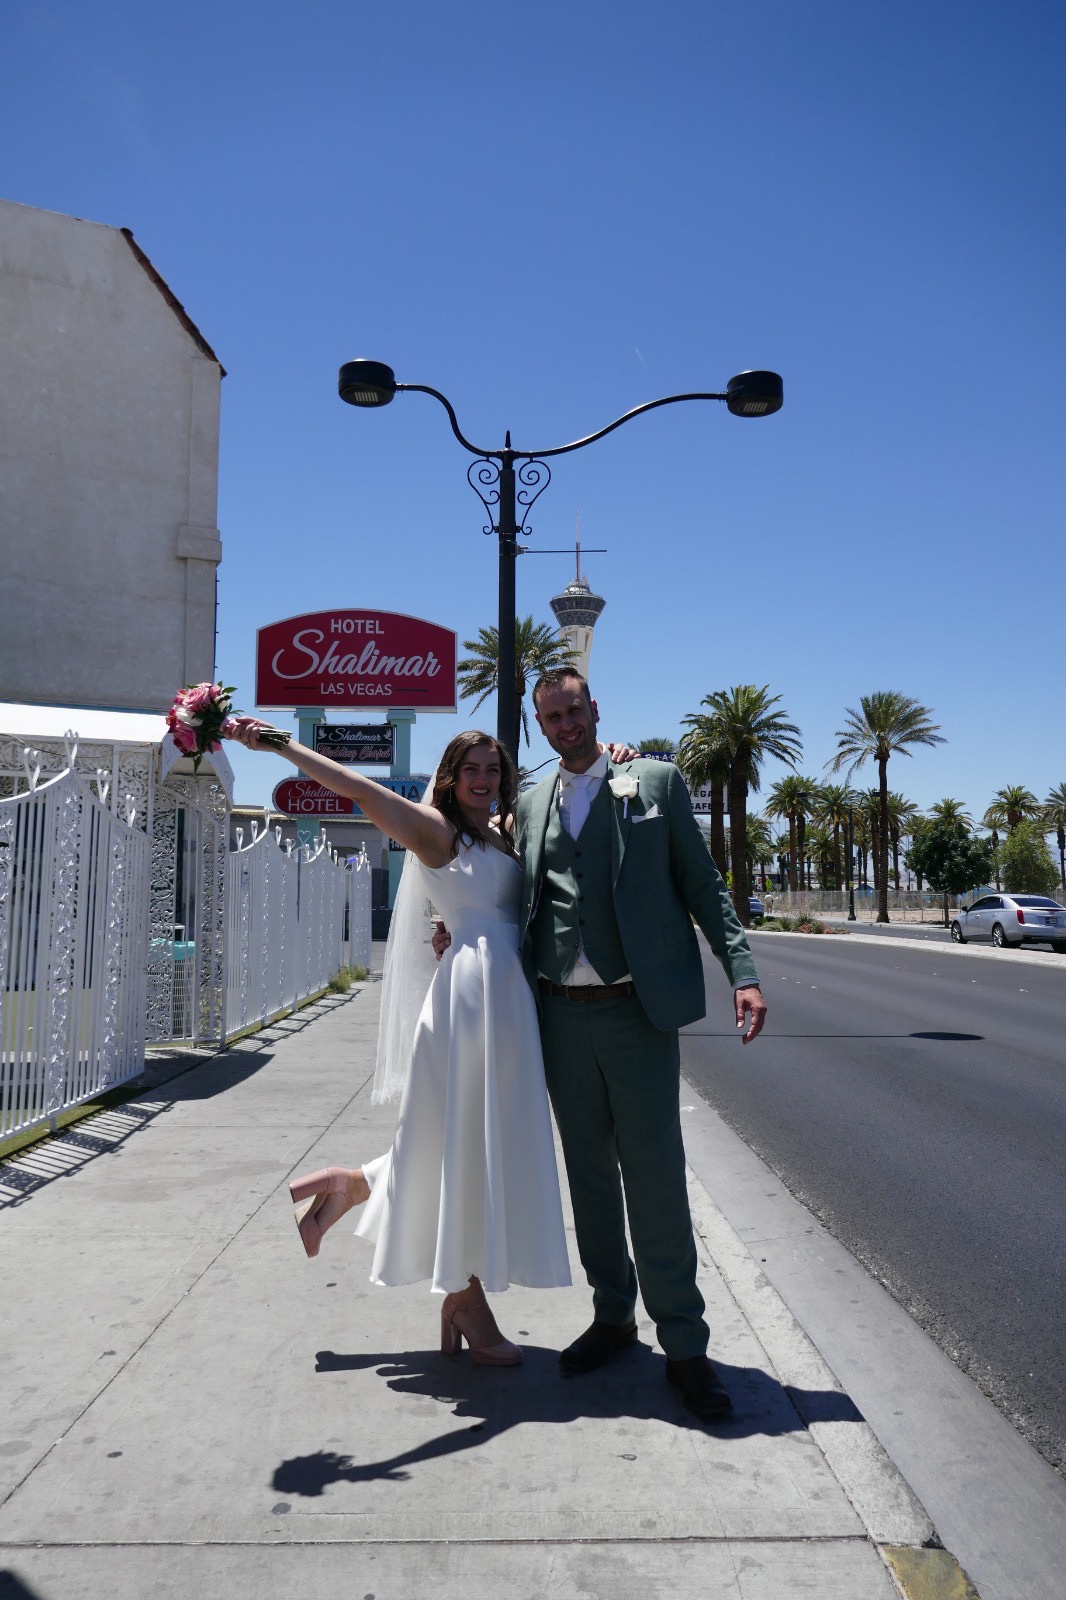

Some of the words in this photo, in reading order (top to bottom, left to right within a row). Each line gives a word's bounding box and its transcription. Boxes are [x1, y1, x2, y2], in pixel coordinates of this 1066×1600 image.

[330, 618, 385, 635] HOTEL
[271, 628, 442, 680] Shalimar
[320, 682, 344, 695] LAS
[348, 683, 393, 696] VEGAS
[328, 727, 382, 742] Shalimar
[318, 745, 358, 762] Wedding
[359, 744, 392, 761] Chapel
[288, 781, 340, 799] Shalima
[288, 798, 345, 812] HOTEL
